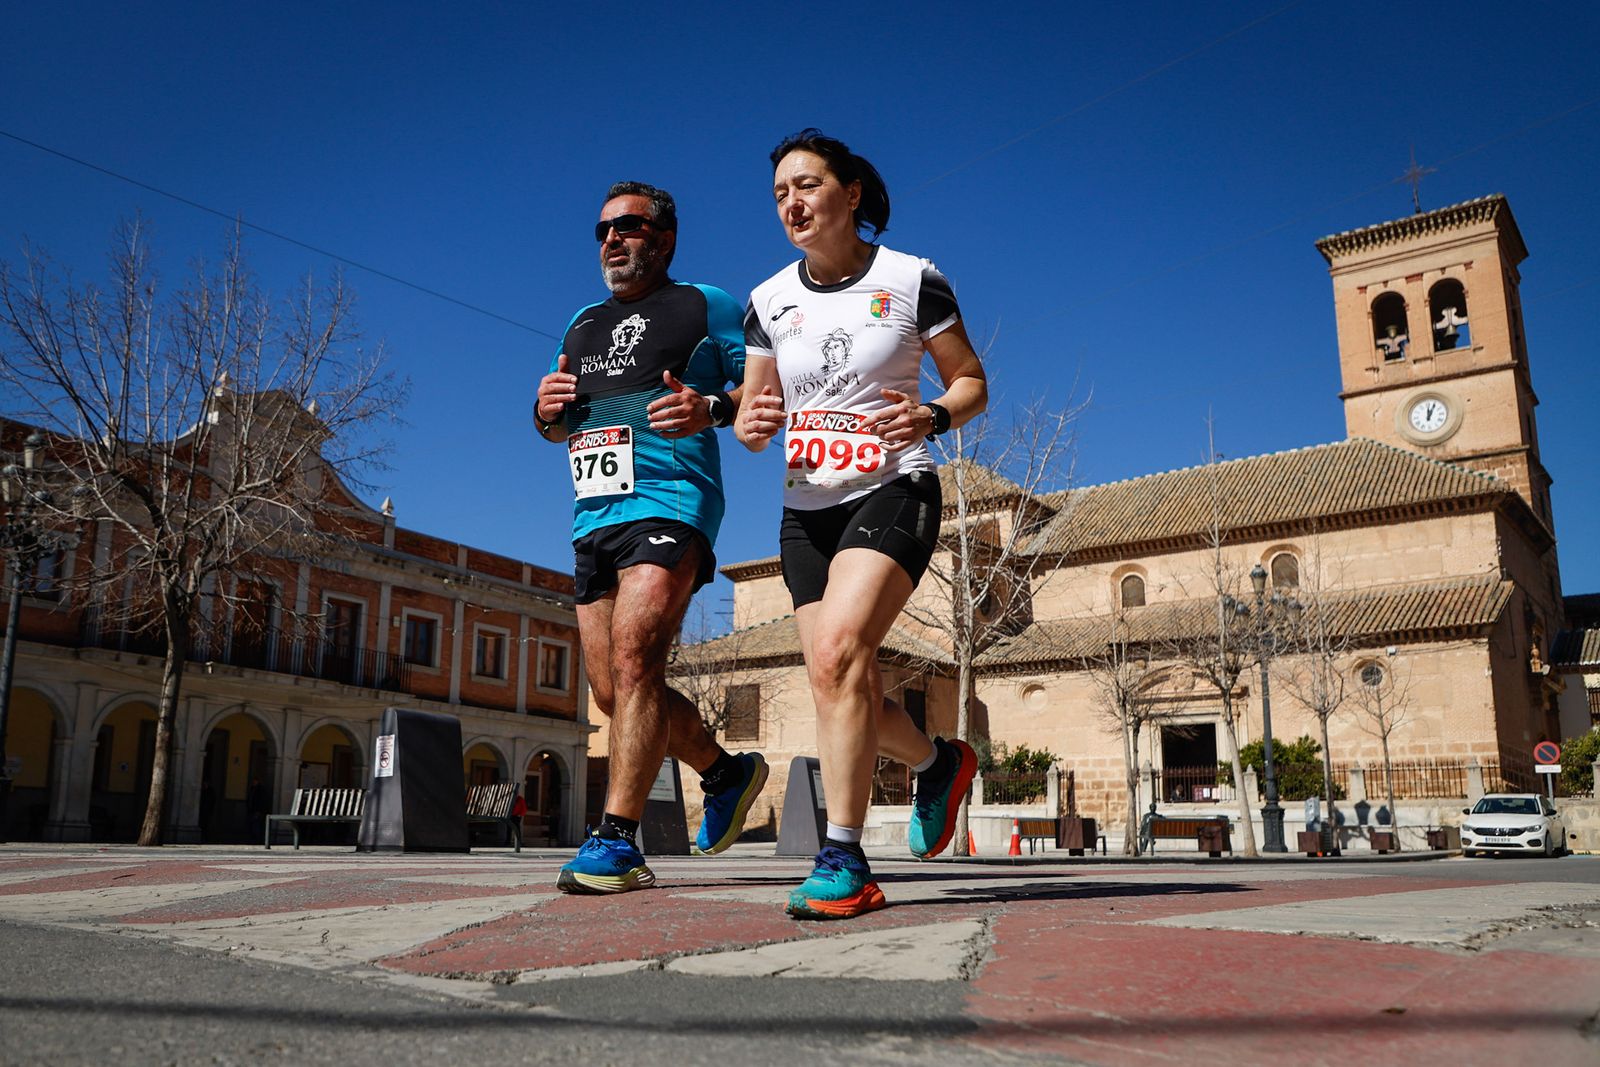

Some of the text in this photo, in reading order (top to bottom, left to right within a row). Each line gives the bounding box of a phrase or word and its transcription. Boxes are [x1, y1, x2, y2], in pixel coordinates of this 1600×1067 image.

[581, 354, 602, 364] VILLA
[581, 355, 637, 375] ROMANA
[790, 372, 816, 385] VILLA
[826, 413, 854, 421] PREMIO
[804, 418, 861, 432] FONDO
[574, 434, 609, 451] FONDO
[788, 437, 881, 473] 2099
[573, 451, 619, 482] 376
